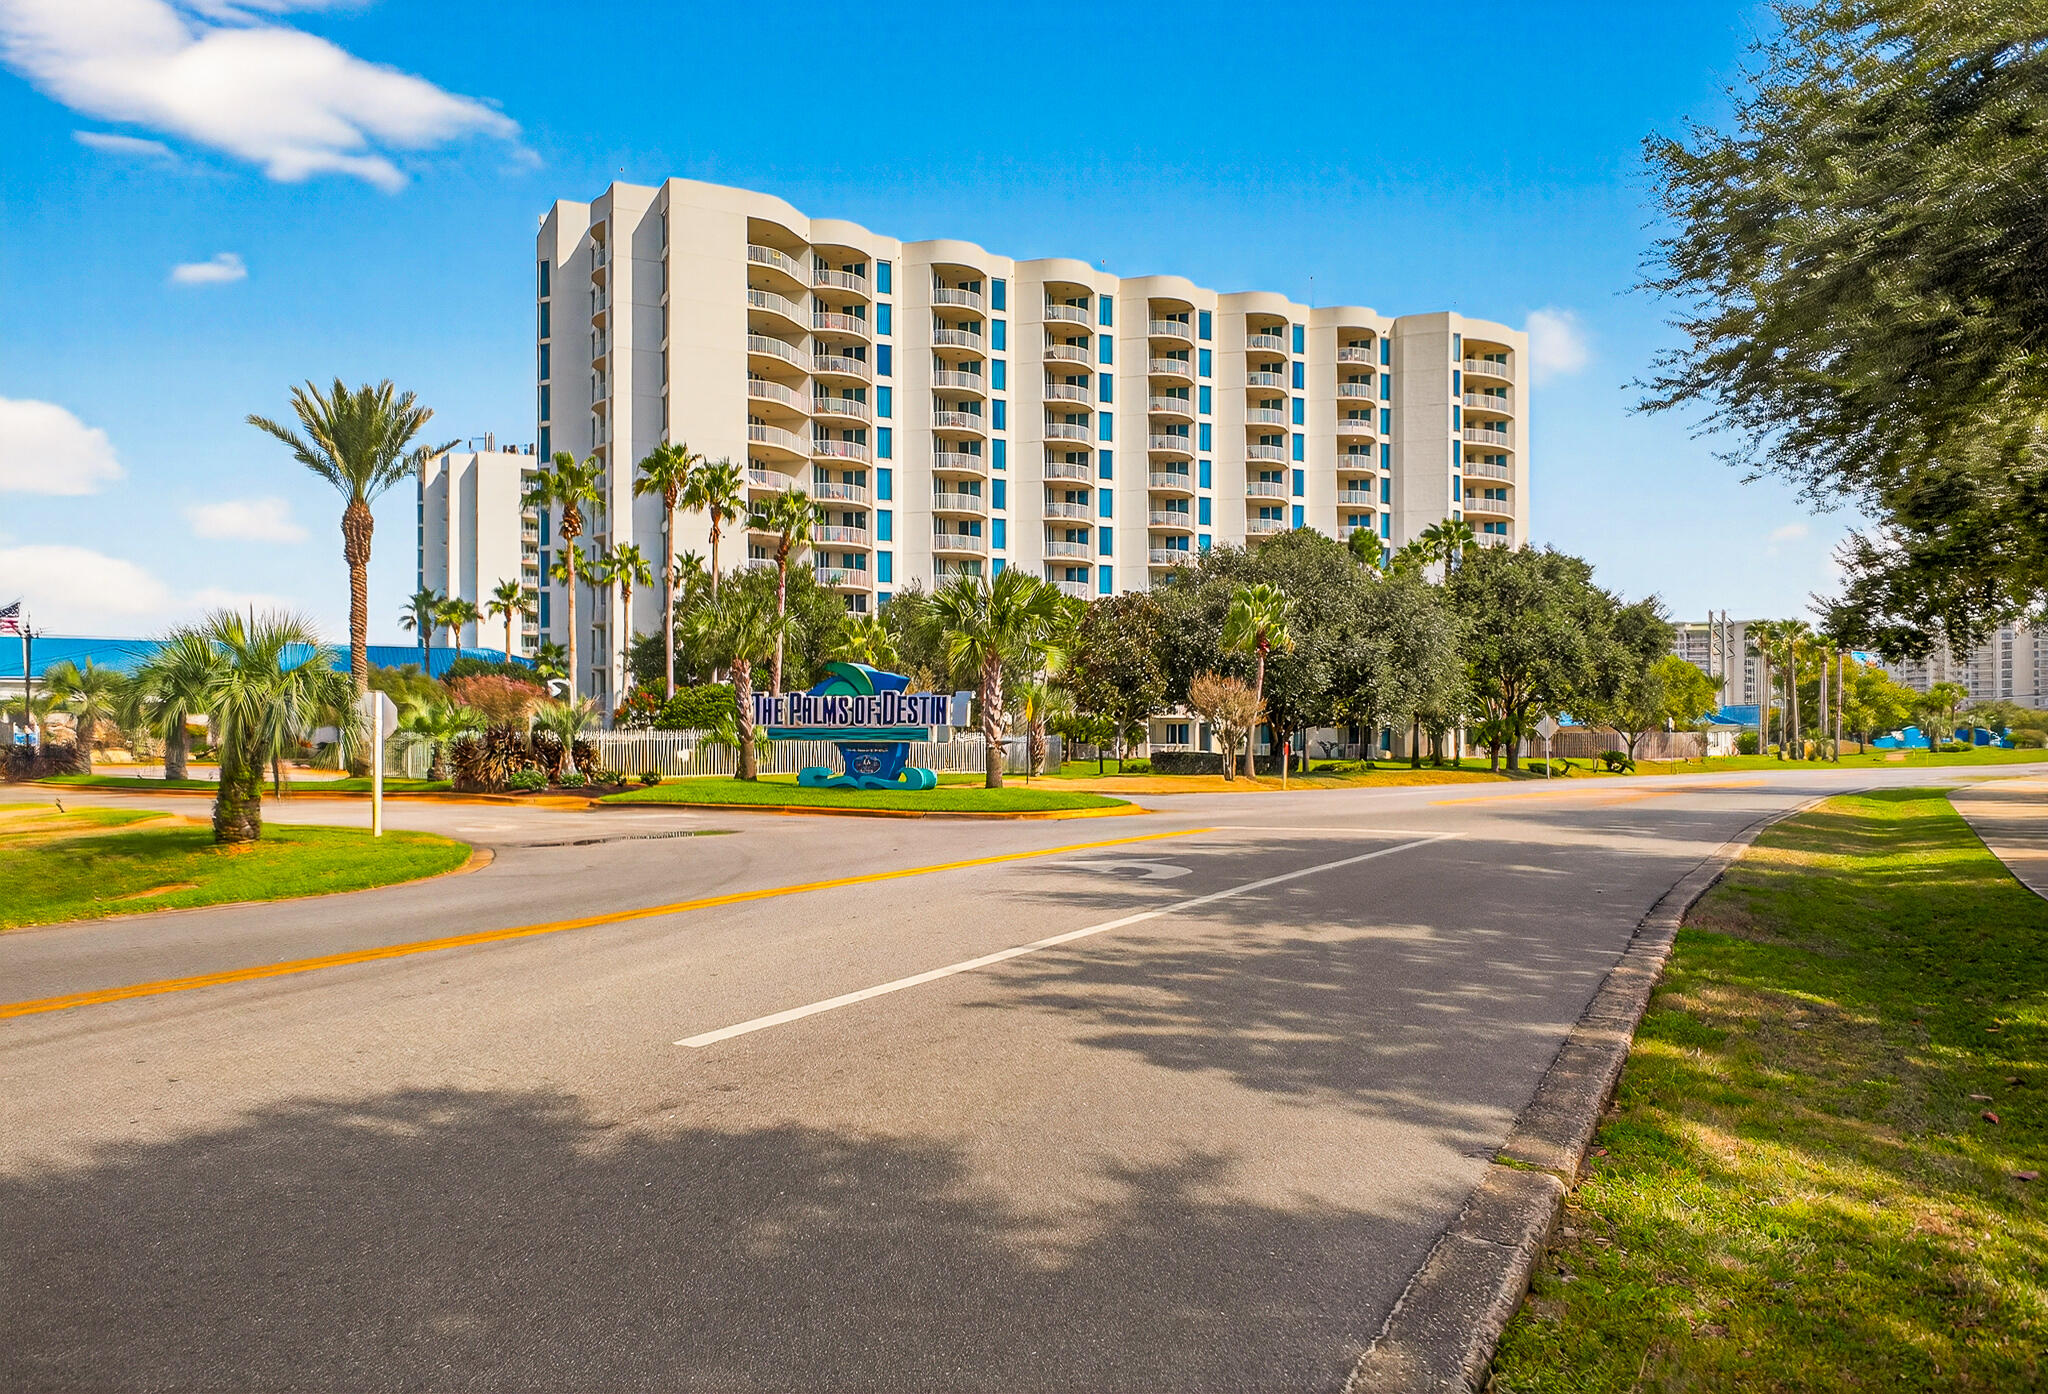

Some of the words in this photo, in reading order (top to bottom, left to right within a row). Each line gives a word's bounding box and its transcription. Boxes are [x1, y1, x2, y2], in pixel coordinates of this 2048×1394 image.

[752, 692, 783, 725] THE
[789, 692, 848, 725] PALMS
[854, 696, 877, 725] OF
[883, 691, 947, 725] DESTIN
